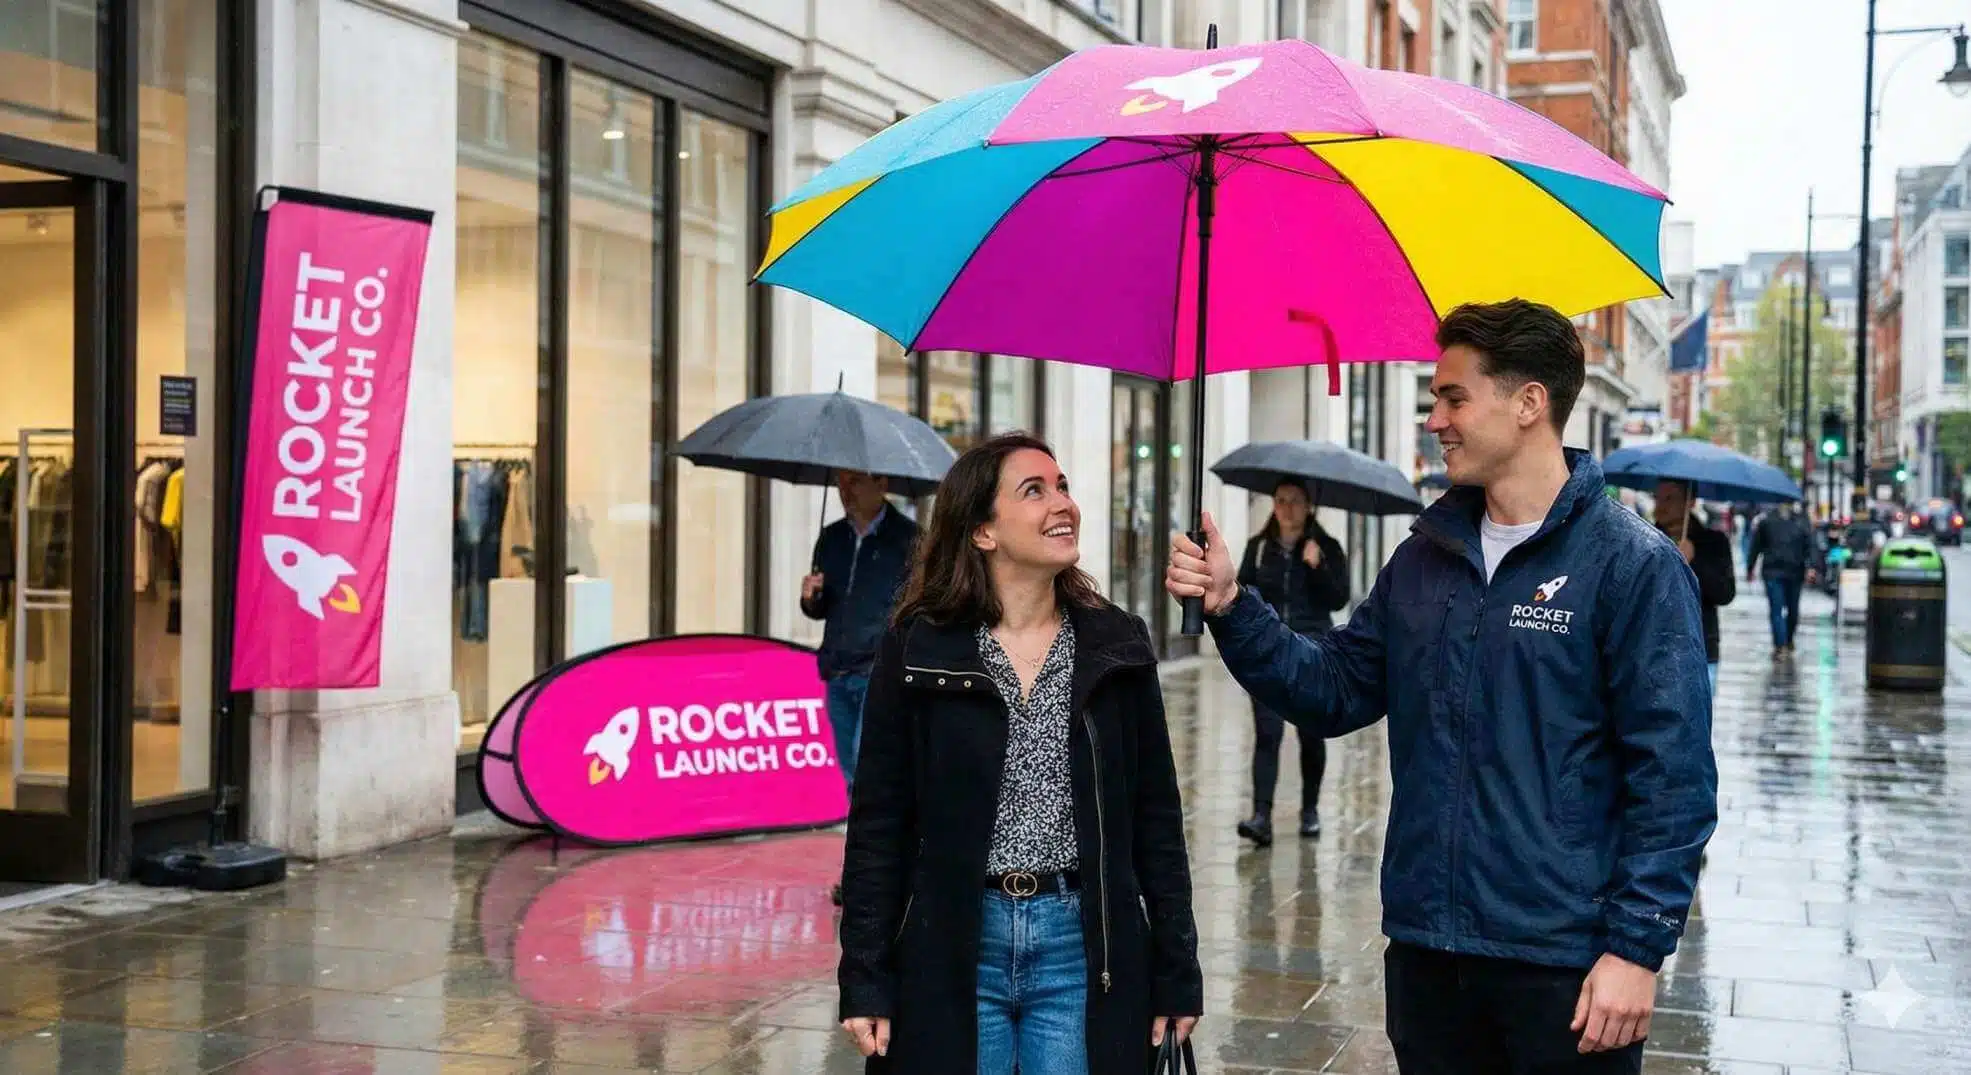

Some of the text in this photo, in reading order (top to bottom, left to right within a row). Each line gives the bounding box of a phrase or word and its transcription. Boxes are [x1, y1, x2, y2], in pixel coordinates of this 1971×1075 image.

[273, 252, 345, 518] ROCKET
[330, 267, 389, 522] LAUNCH CO.
[1508, 618, 1571, 634] LAUNCH CO.
[1511, 604, 1574, 623] ROCKET
[648, 698, 824, 745] ROCKET
[655, 742, 834, 778] LAUNCH CO.
